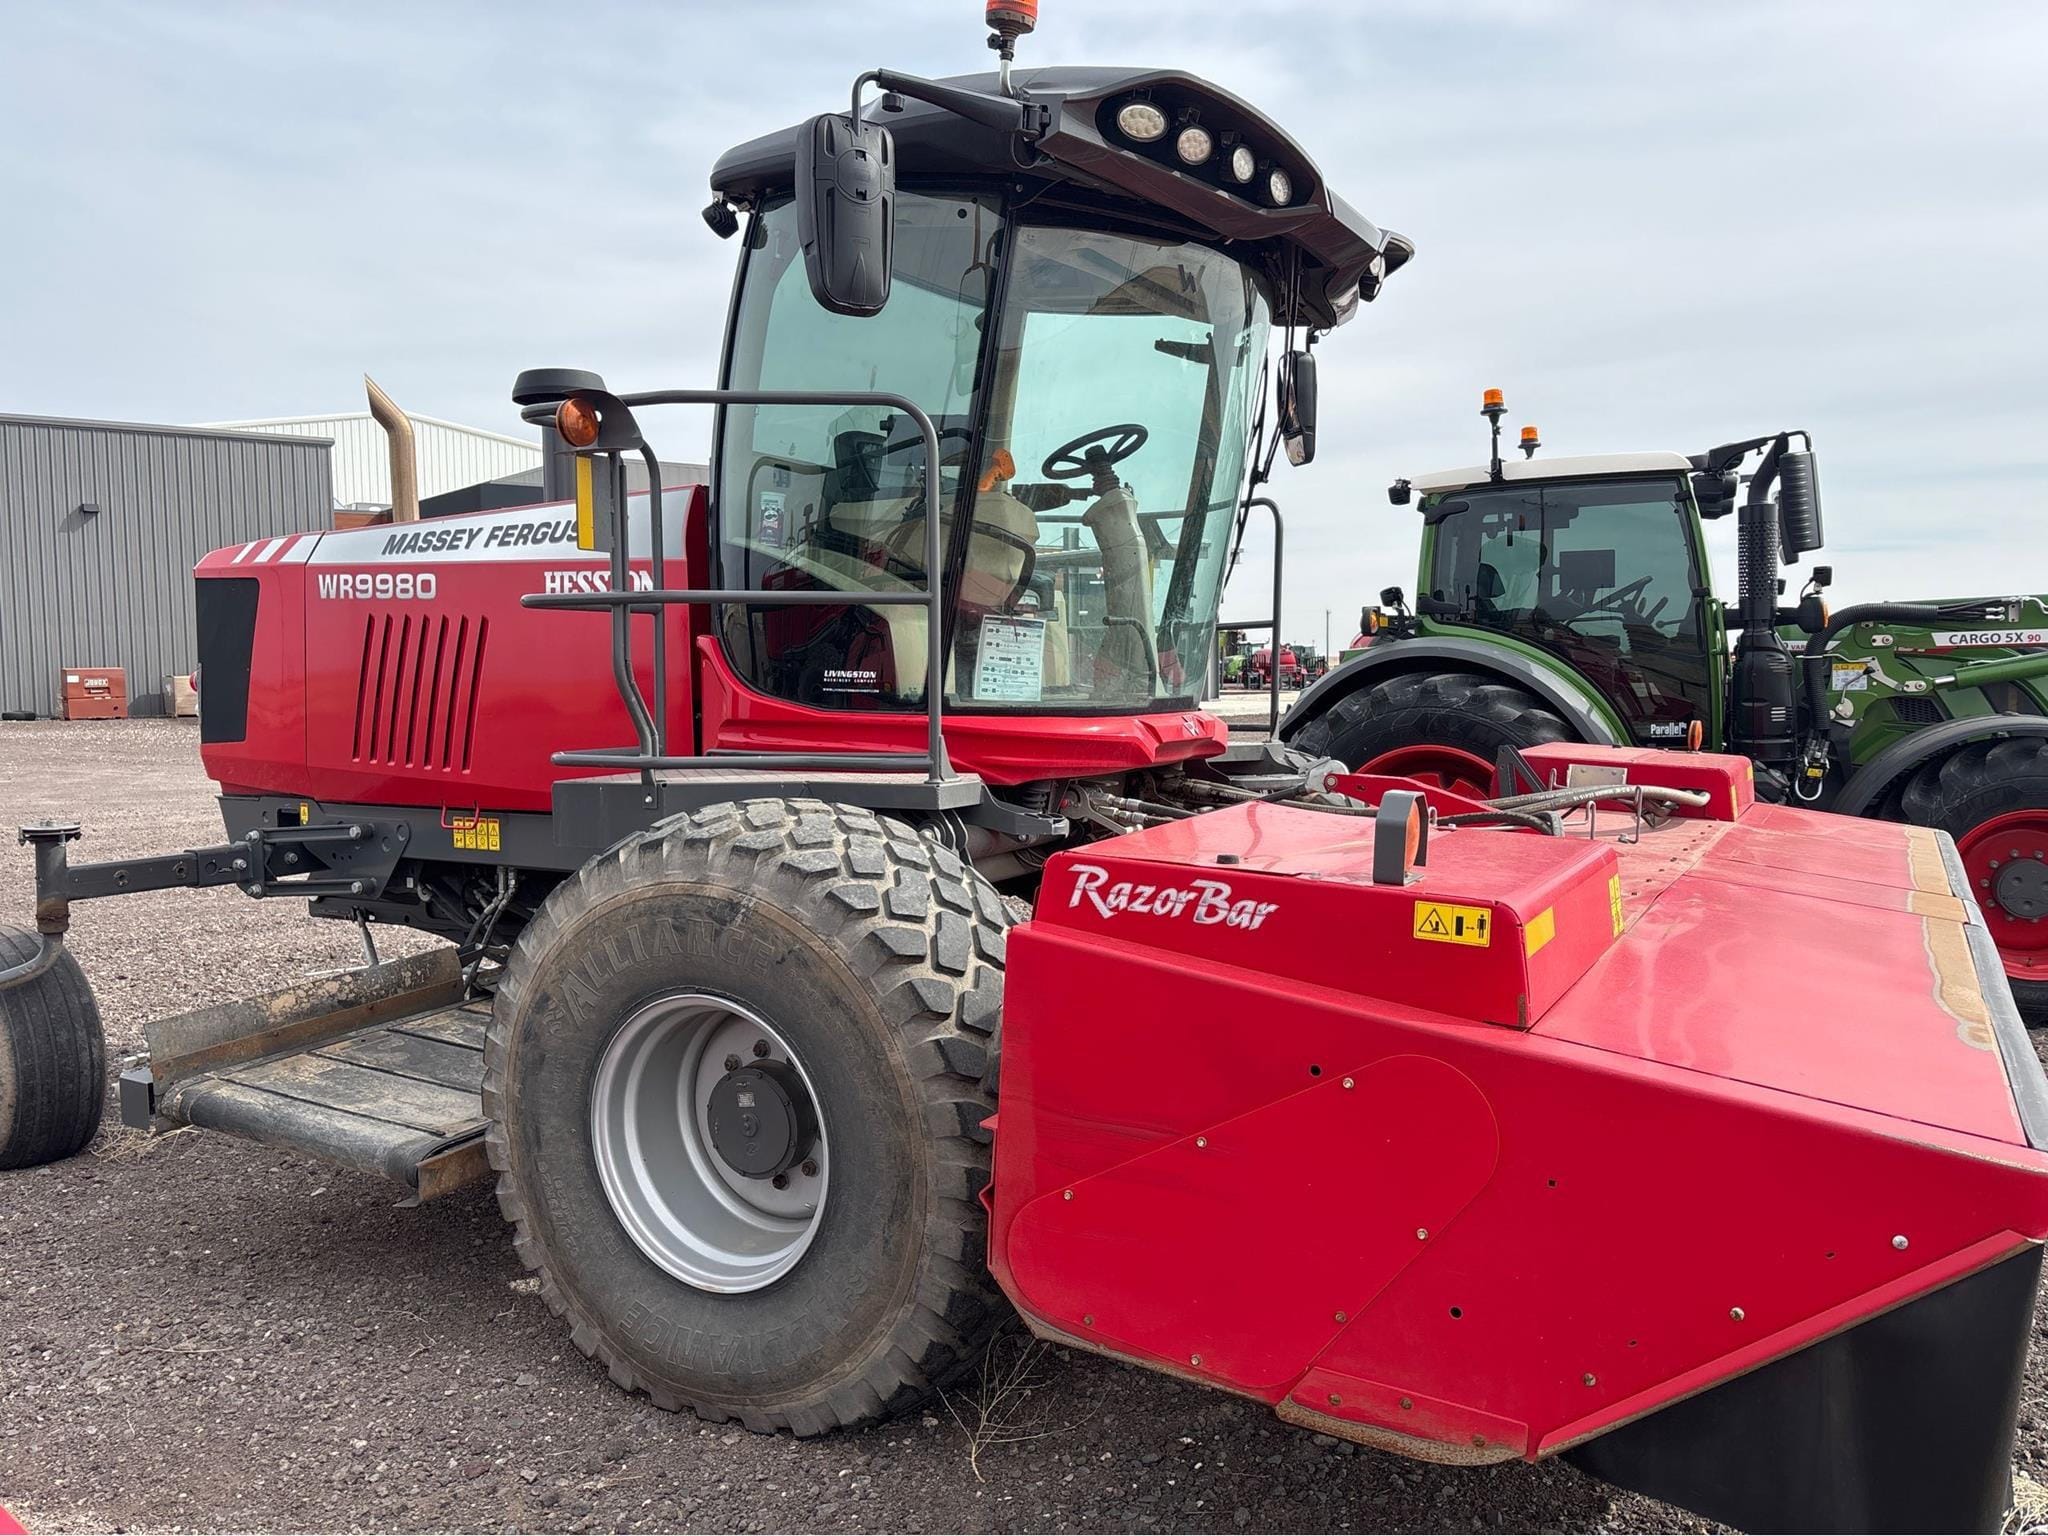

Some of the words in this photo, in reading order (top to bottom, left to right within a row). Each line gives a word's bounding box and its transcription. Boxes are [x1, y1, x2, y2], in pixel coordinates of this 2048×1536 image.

[381, 527, 483, 556] MASSEY
[484, 520, 578, 548] FERGUS
[318, 573, 437, 600] WR9980
[544, 570, 655, 594] HESSON
[1948, 633, 2001, 645] CARGO
[2005, 632, 2024, 643] 5X
[2027, 634, 2042, 642] 90
[824, 670, 877, 678] LIVINGSTON
[1650, 722, 1682, 735] Parallel
[1067, 863, 1280, 931] RazorBar
[560, 917, 776, 1032] ALLIANCE
